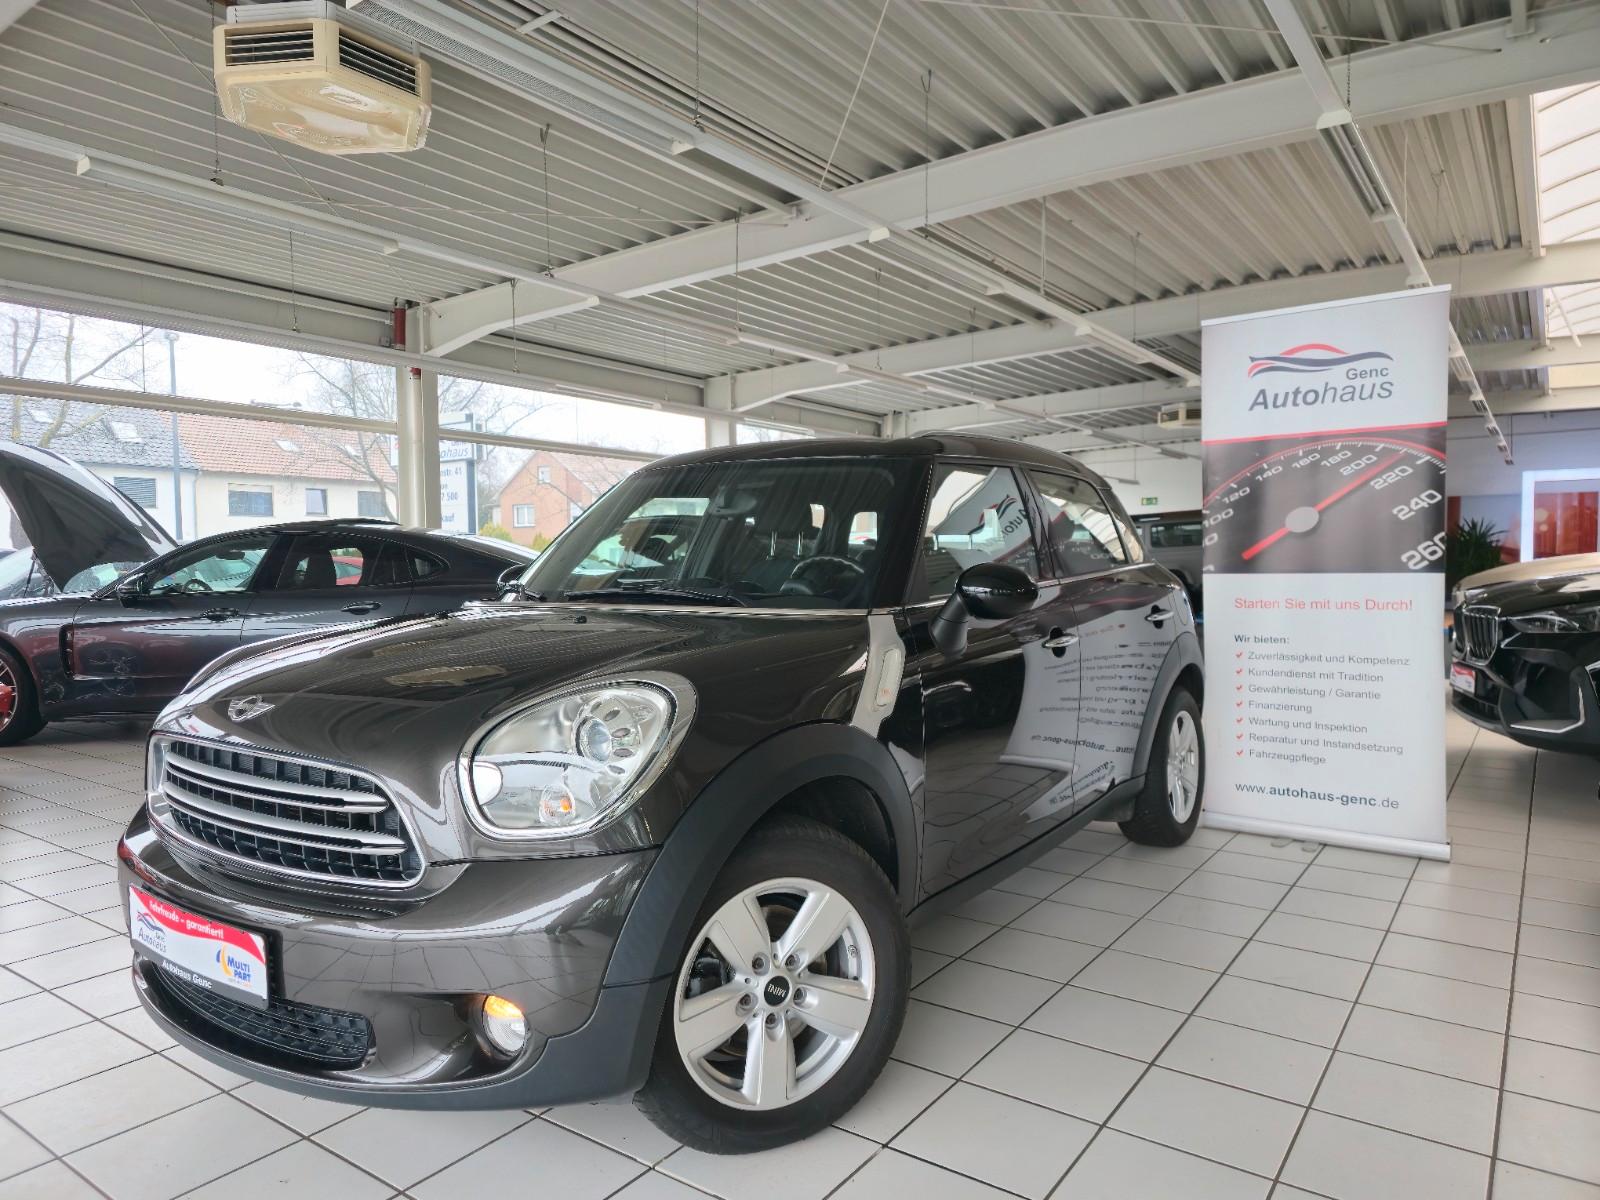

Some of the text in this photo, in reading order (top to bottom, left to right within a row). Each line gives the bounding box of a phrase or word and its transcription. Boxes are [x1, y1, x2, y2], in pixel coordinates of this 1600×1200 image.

[1346, 367, 1389, 380] Genc
[1248, 382, 1394, 411] Autohaus
[1202, 507, 1234, 528] 100
[1221, 486, 1251, 505] 120
[1255, 465, 1284, 482] 140
[1339, 454, 1378, 476] 200
[1370, 465, 1413, 490] 220
[1392, 489, 1442, 520] 240
[1234, 598, 1413, 611] Starten Sie mit uns Durch!
[1234, 634, 1290, 645] Wir bieten:
[1248, 651, 1410, 667] Zuverlässigkeit und Kompetenz
[1248, 667, 1384, 682] Kundendienst mit Tradition
[1248, 684, 1326, 698] Gewährleistung
[1335, 688, 1381, 700] Garantie
[1248, 701, 1312, 714] Finanzierung
[1248, 717, 1368, 734] Wartung und Inspektion
[1249, 733, 1403, 755] Reparatur und Instandsetzung
[1249, 750, 1326, 765] Fahrzeugpflege
[1235, 782, 1399, 810] www.autohaus-genc.de
[227, 955, 250, 973] MULTI
[162, 960, 192, 982] Autohaus
[193, 974, 212, 989] Genc
[234, 971, 251, 982] PART
